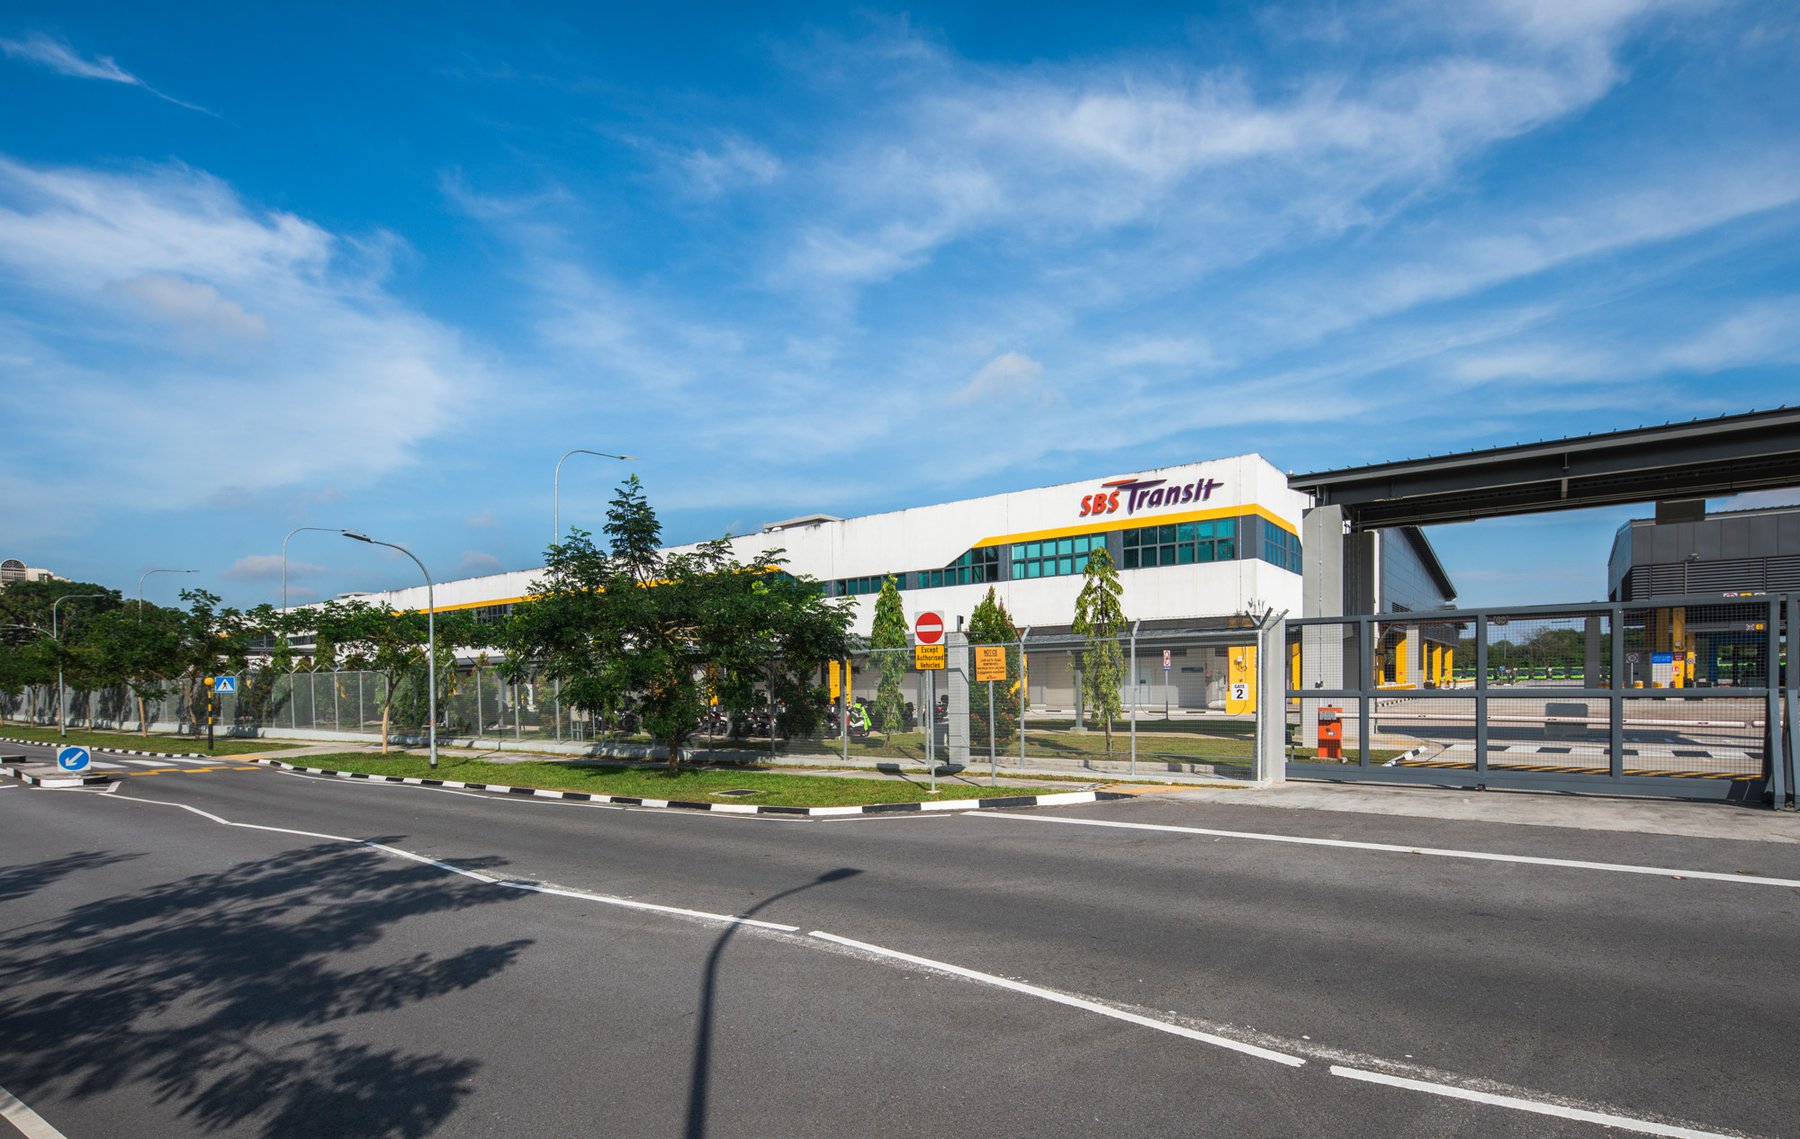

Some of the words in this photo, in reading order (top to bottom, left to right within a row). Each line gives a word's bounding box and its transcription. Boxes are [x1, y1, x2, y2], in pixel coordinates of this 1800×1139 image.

[1080, 490, 1120, 517] SBS
[1117, 478, 1224, 515] Transit
[921, 647, 939, 655] Except
[1236, 689, 1243, 699] 2
